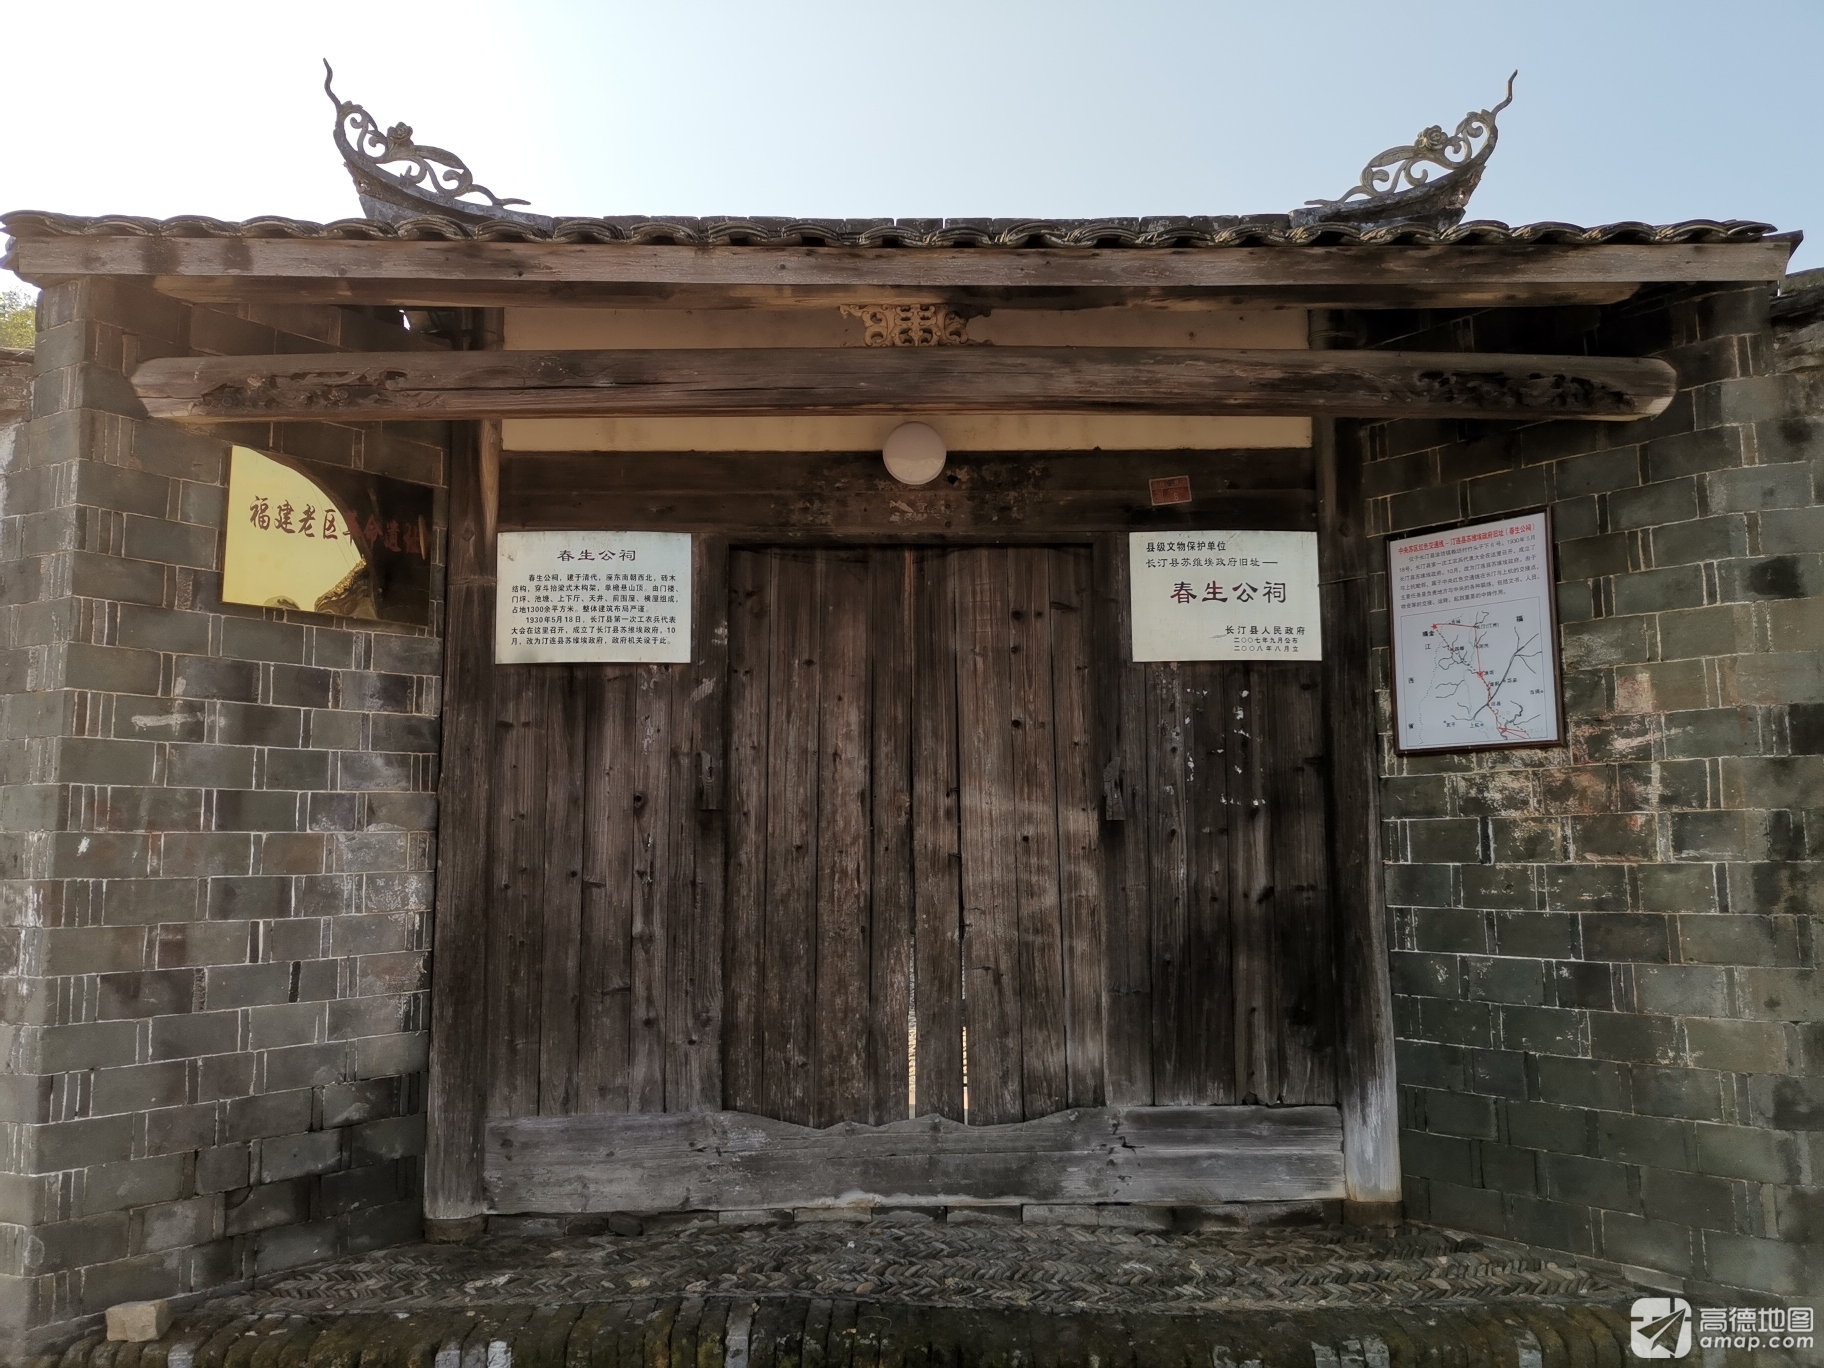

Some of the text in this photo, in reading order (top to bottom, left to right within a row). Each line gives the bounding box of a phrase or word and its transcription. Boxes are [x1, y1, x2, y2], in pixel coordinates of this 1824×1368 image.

[1146, 541, 1226, 552] 县级文物保护单位
[557, 549, 637, 562] 春生公祠
[1170, 580, 1287, 604] 春生公祠
[1225, 625, 1306, 635] 长汀县人民政府
